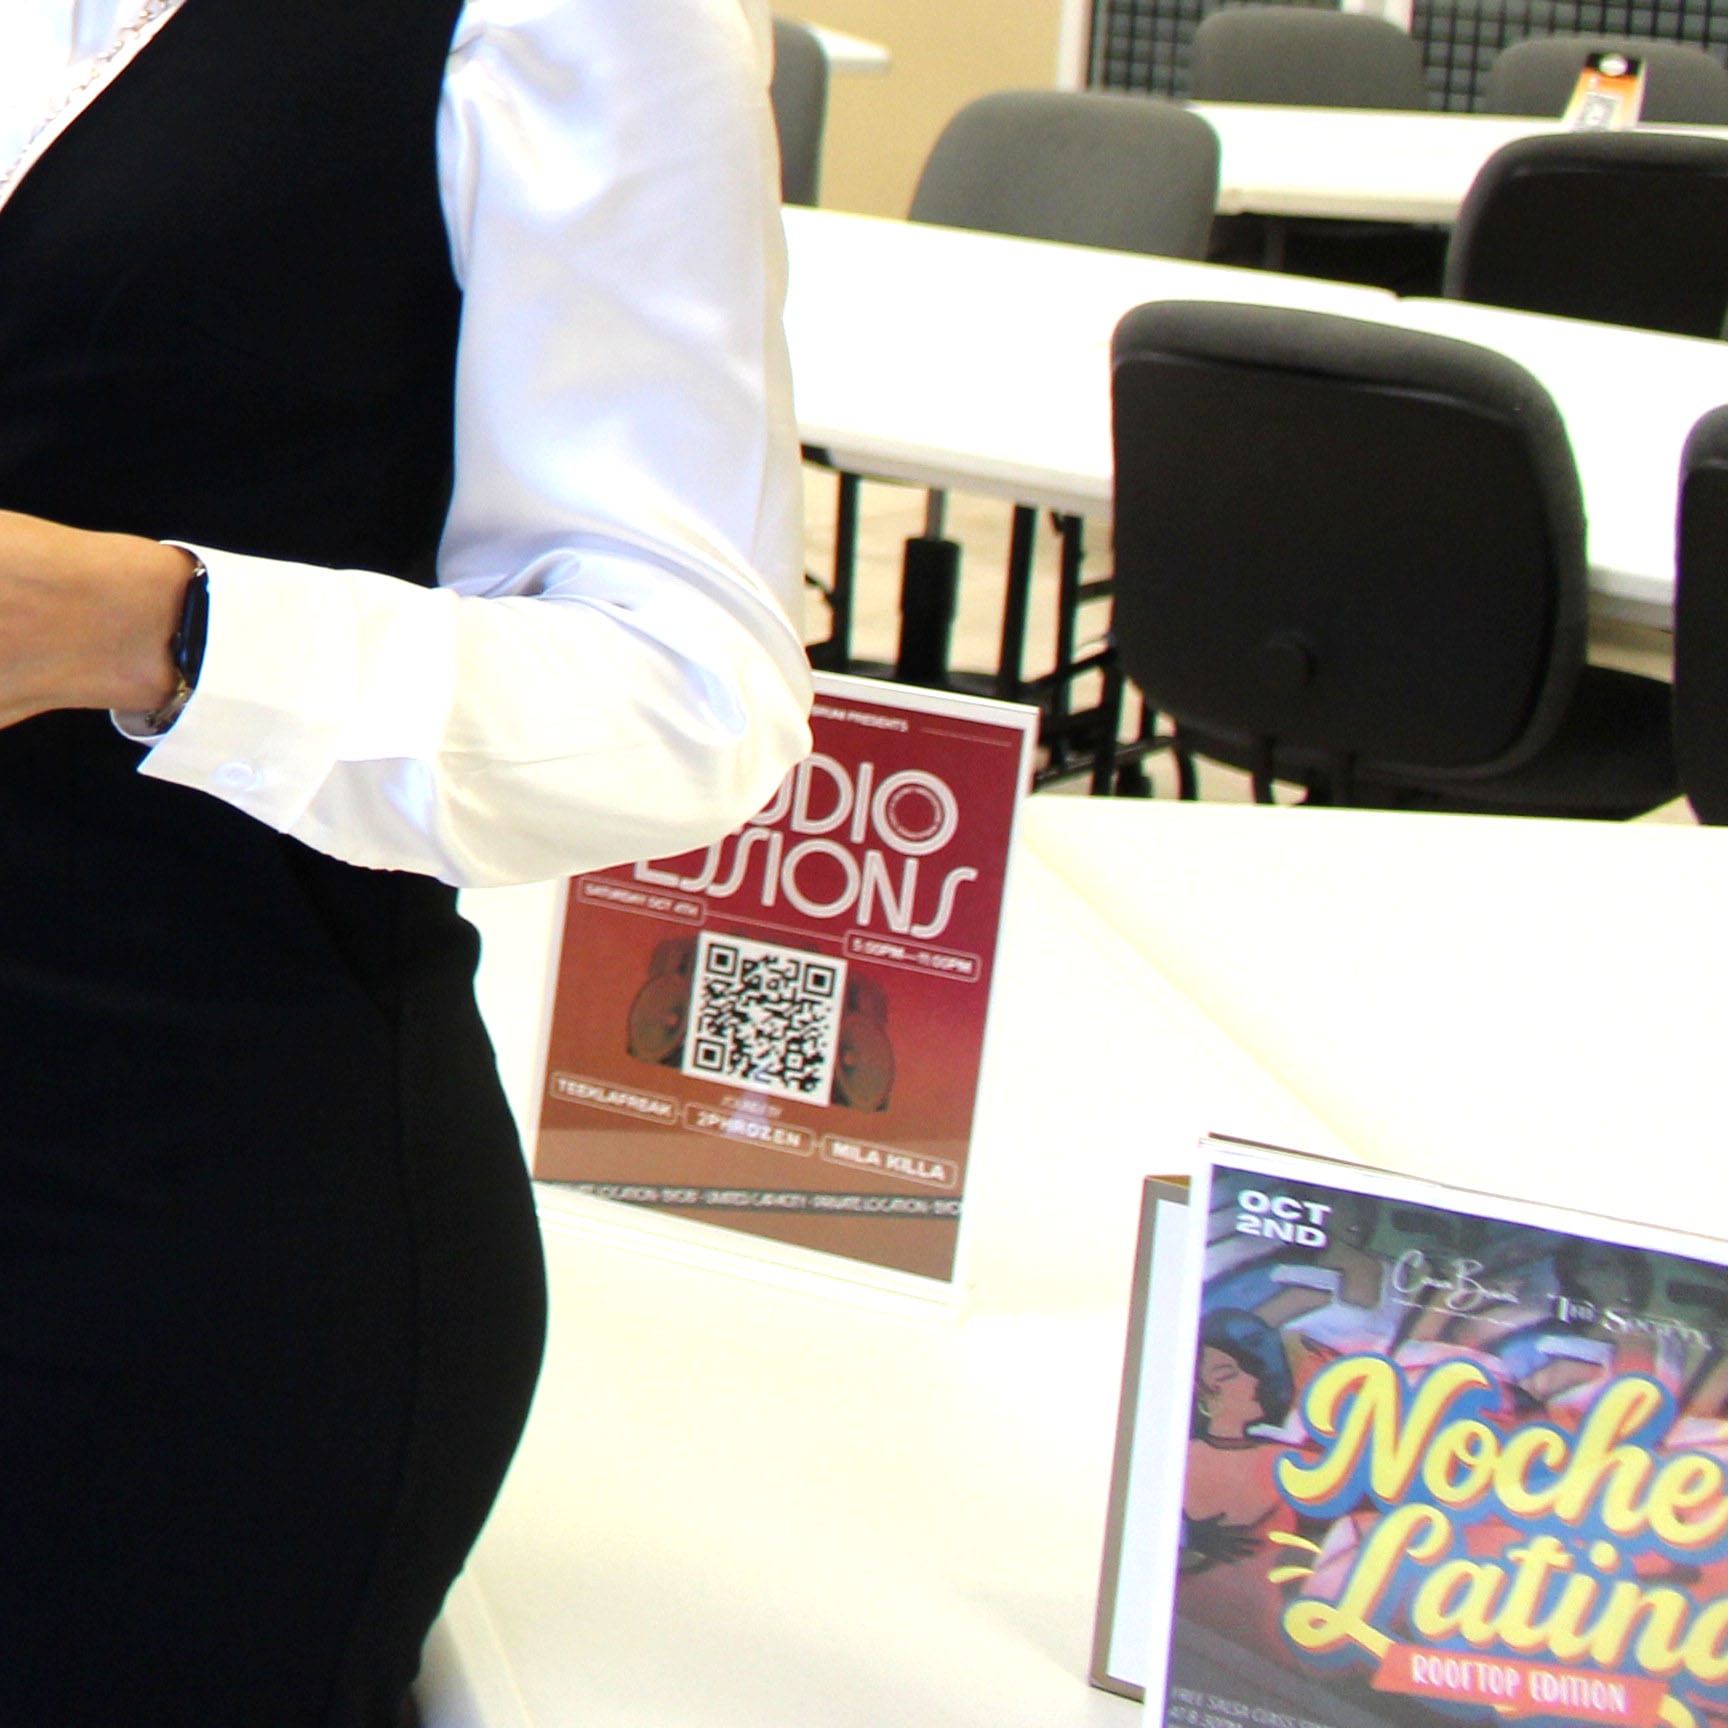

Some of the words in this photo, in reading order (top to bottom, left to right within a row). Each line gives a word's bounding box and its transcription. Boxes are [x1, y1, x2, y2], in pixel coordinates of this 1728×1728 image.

[885, 1154, 946, 1183] KILLA
[1237, 1189, 1333, 1226] OCT
[1235, 1213, 1328, 1248] 2ND
[1278, 1355, 1728, 1546] Noche
[1411, 1653, 1522, 1699] ROOFTOP
[1528, 1668, 1627, 1714] EDITION
